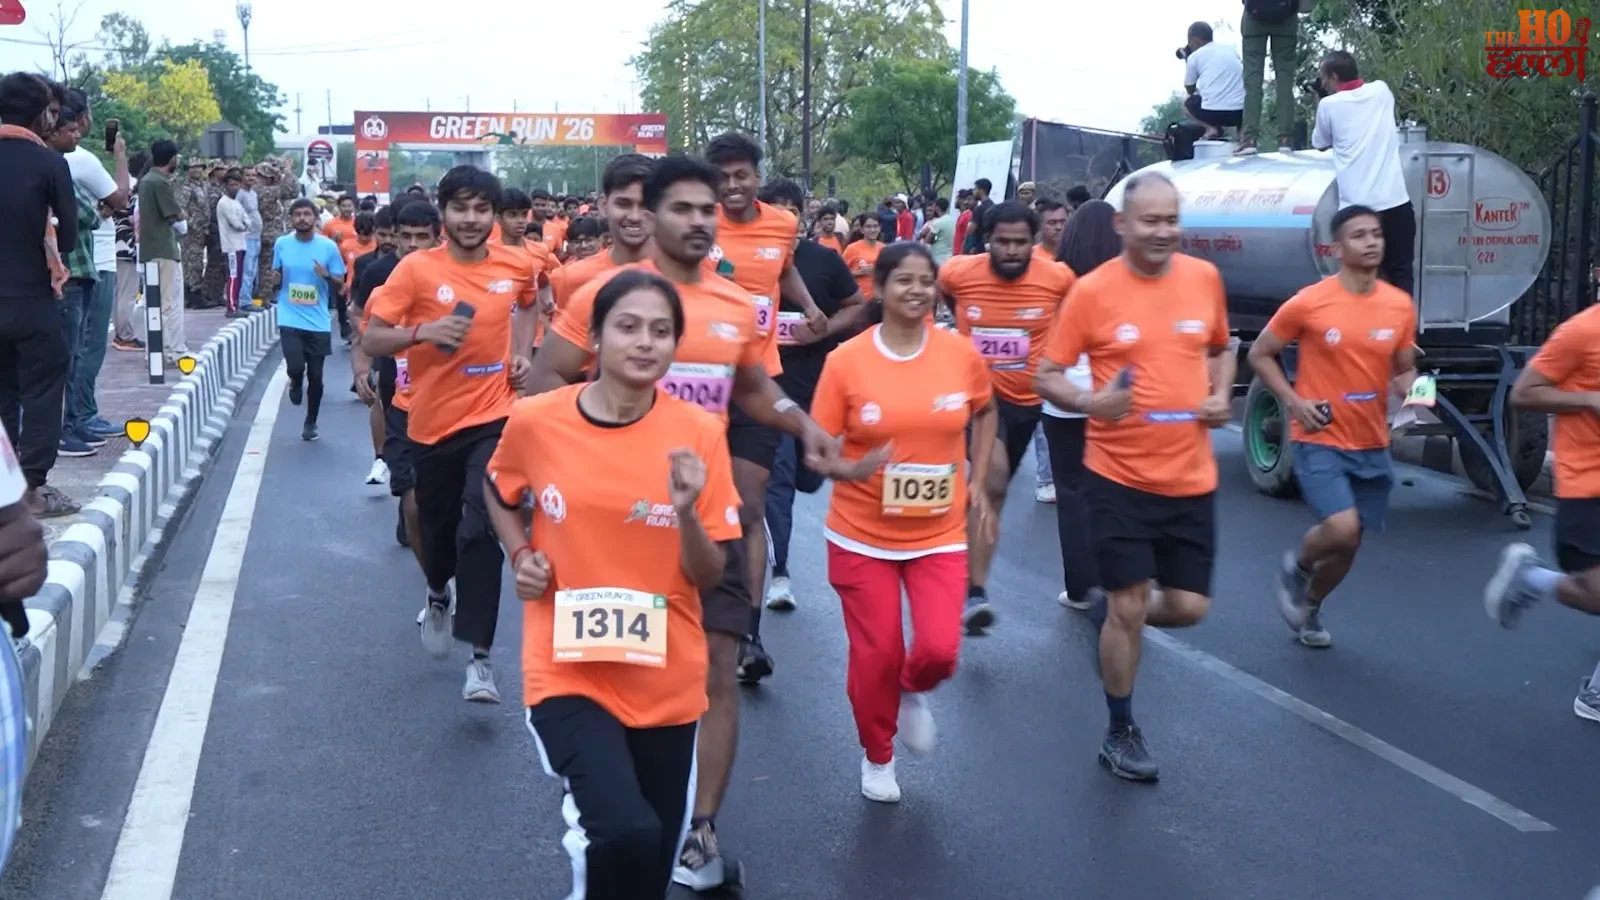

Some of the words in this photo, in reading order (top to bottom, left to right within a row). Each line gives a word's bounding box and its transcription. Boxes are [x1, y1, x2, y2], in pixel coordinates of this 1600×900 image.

[430, 115, 507, 140] GREEN
[508, 116, 556, 140] RUN
[1427, 169, 1447, 195] 13
[291, 288, 316, 300] 2096
[981, 340, 1019, 355] 2141
[892, 477, 949, 500] 1036
[572, 607, 650, 642] 1314
